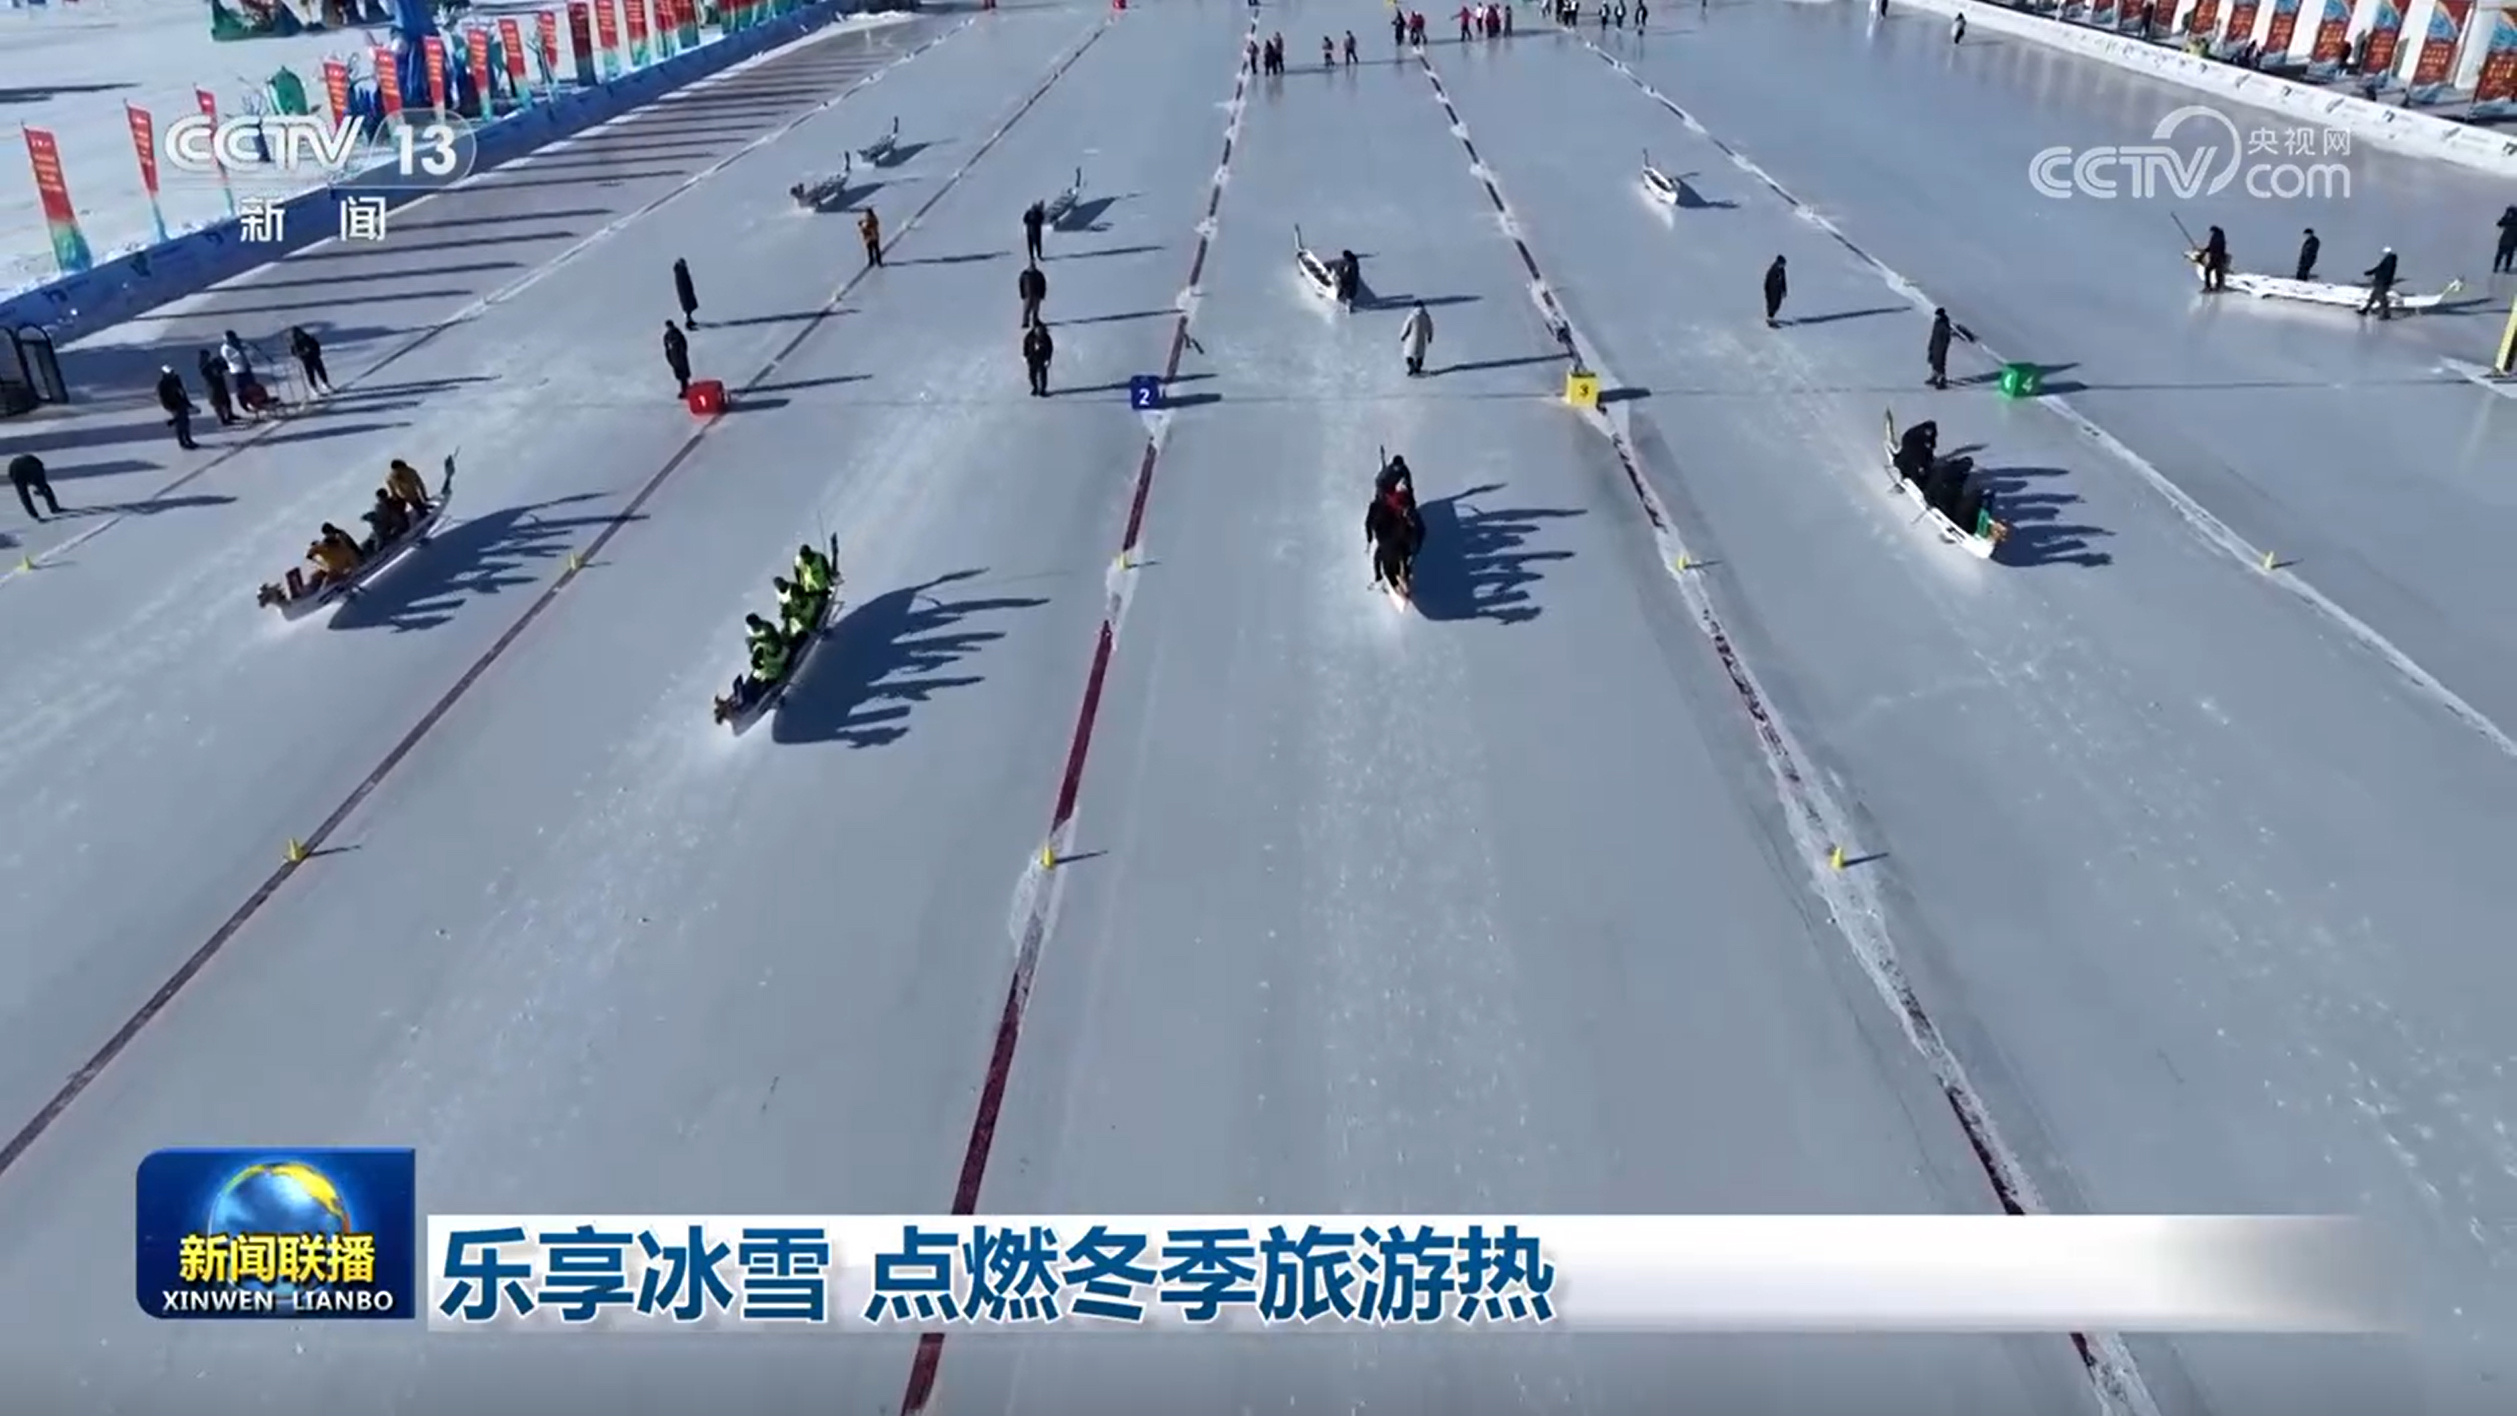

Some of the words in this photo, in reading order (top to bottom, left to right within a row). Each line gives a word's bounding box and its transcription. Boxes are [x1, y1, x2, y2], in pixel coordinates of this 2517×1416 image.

[1579, 383, 1589, 397] 3
[2021, 374, 2034, 393] 4
[1138, 387, 1150, 406] 2
